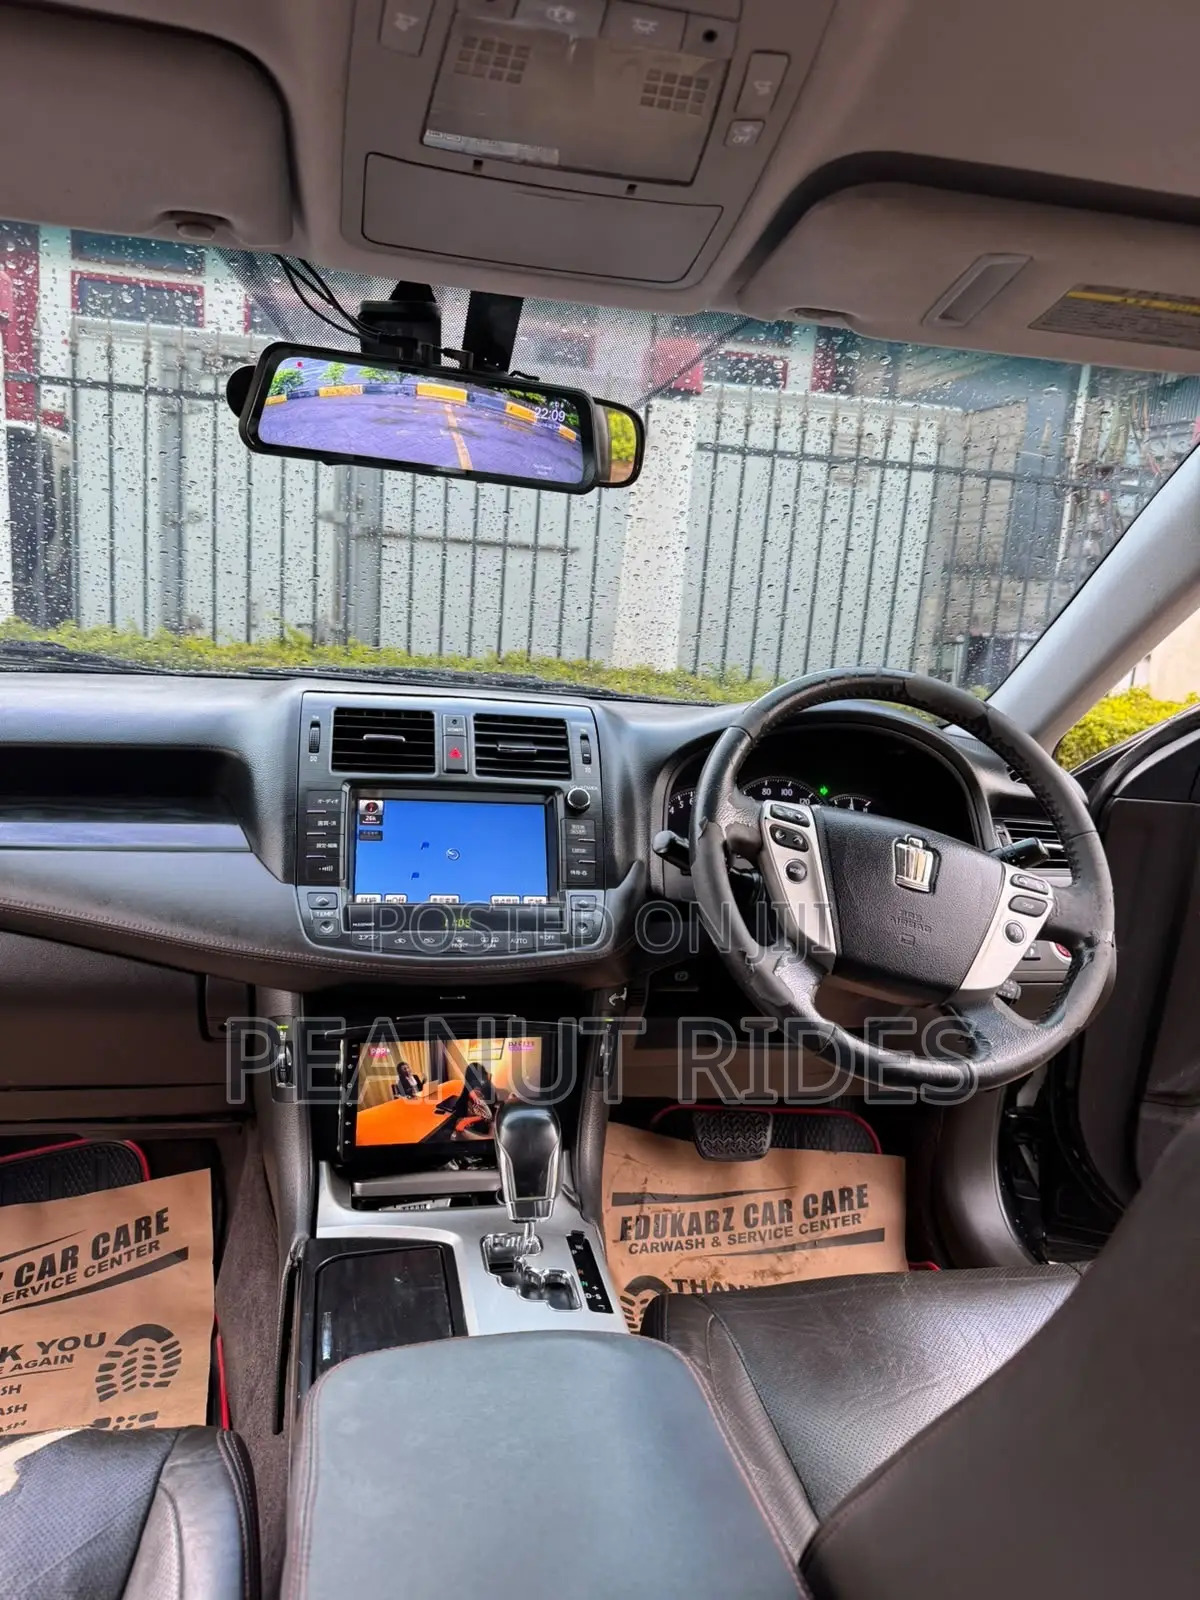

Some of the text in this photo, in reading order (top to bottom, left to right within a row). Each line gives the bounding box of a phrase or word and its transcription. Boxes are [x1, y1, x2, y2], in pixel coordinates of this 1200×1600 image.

[534, 406, 566, 422] 22:09
[761, 787, 772, 796] 80
[780, 788, 793, 797] 100
[668, 805, 675, 815] 4
[679, 800, 684, 809] 5
[510, 937, 528, 945] AUTO
[620, 1184, 869, 1242] EDUKABZ CAR CARE
[628, 1213, 862, 1255] CARWASH & SERVICE CENTER
[14, 1206, 170, 1289] CAR CARE
[0, 1239, 161, 1304] ERVICE CENTER
[36, 1331, 108, 1355] YOU
[10, 1353, 75, 1373] AGAIN
